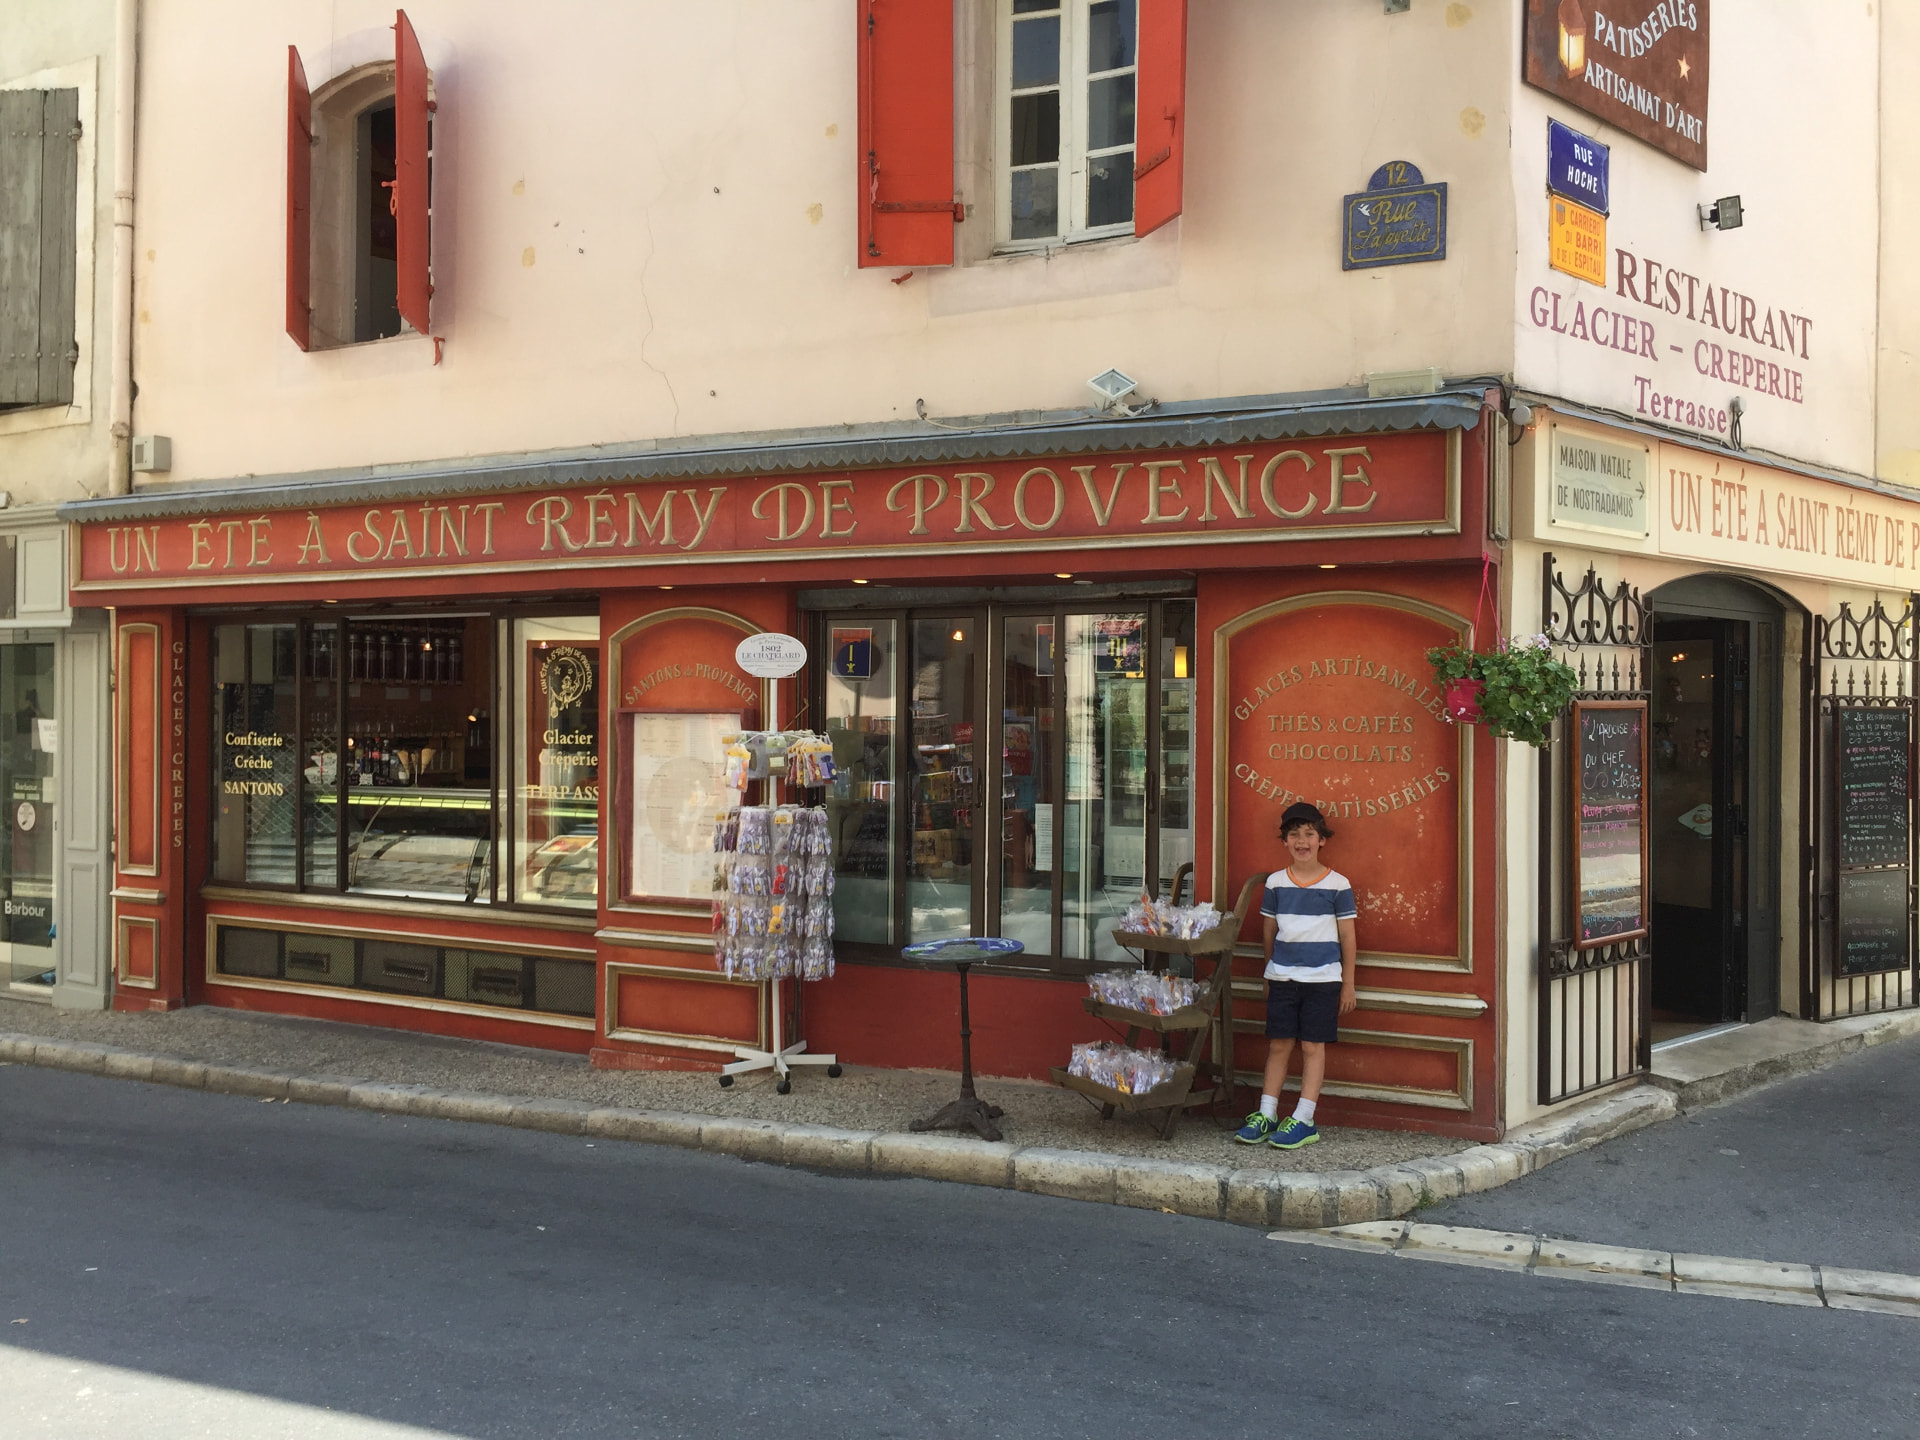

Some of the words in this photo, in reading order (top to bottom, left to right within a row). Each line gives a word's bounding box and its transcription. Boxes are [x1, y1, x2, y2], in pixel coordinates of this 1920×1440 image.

[1594, 0, 1697, 58] PATISSERIES
[1584, 58, 1661, 122] ARTISANAT
[1666, 102, 1702, 145] D'ART
[1574, 143, 1594, 167] RUE
[1386, 163, 1409, 187] 12
[1567, 165, 1598, 194] HOCHE
[1369, 200, 1417, 225] Rue
[1576, 231, 1601, 257] BARRI
[1615, 248, 1813, 361] RESTAURANT
[1530, 285, 1658, 361] GLACIER
[1694, 339, 1804, 404] CREPERIE
[1634, 375, 1727, 434] Terrasse
[1560, 445, 1596, 472] MAISON
[1600, 454, 1632, 480] NATALE
[107, 525, 160, 574] UN
[187, 514, 275, 571] ÉTÉ
[526, 486, 728, 553] RÉMY
[751, 479, 858, 541] DE
[885, 446, 1378, 536] PROVENCE
[1557, 484, 1569, 507] DE
[1573, 487, 1634, 518] NOSTRADAMUS
[1669, 468, 1703, 534] UN
[1711, 461, 1748, 542] ÉTÉ
[1755, 489, 1770, 545] A
[1776, 492, 1829, 556] SAINT
[1835, 493, 1879, 564] RÉMY
[1884, 516, 1905, 568] DE
[624, 664, 682, 705] SANTONS
[695, 663, 758, 706] PROVENCE
[1234, 665, 1303, 721] GLACES
[543, 729, 594, 745] Glacier
[1267, 711, 1322, 733] THÉS
[1327, 718, 1339, 733] &
[1342, 711, 1414, 733] CAFÉS
[225, 731, 283, 747] Confiserie
[1268, 743, 1413, 763] CHOCOLATS
[538, 750, 599, 771] Crêperie
[224, 780, 284, 797] SANTONS
[1315, 765, 1451, 818] PATISSERIES
[4, 900, 45, 917] Barbour
